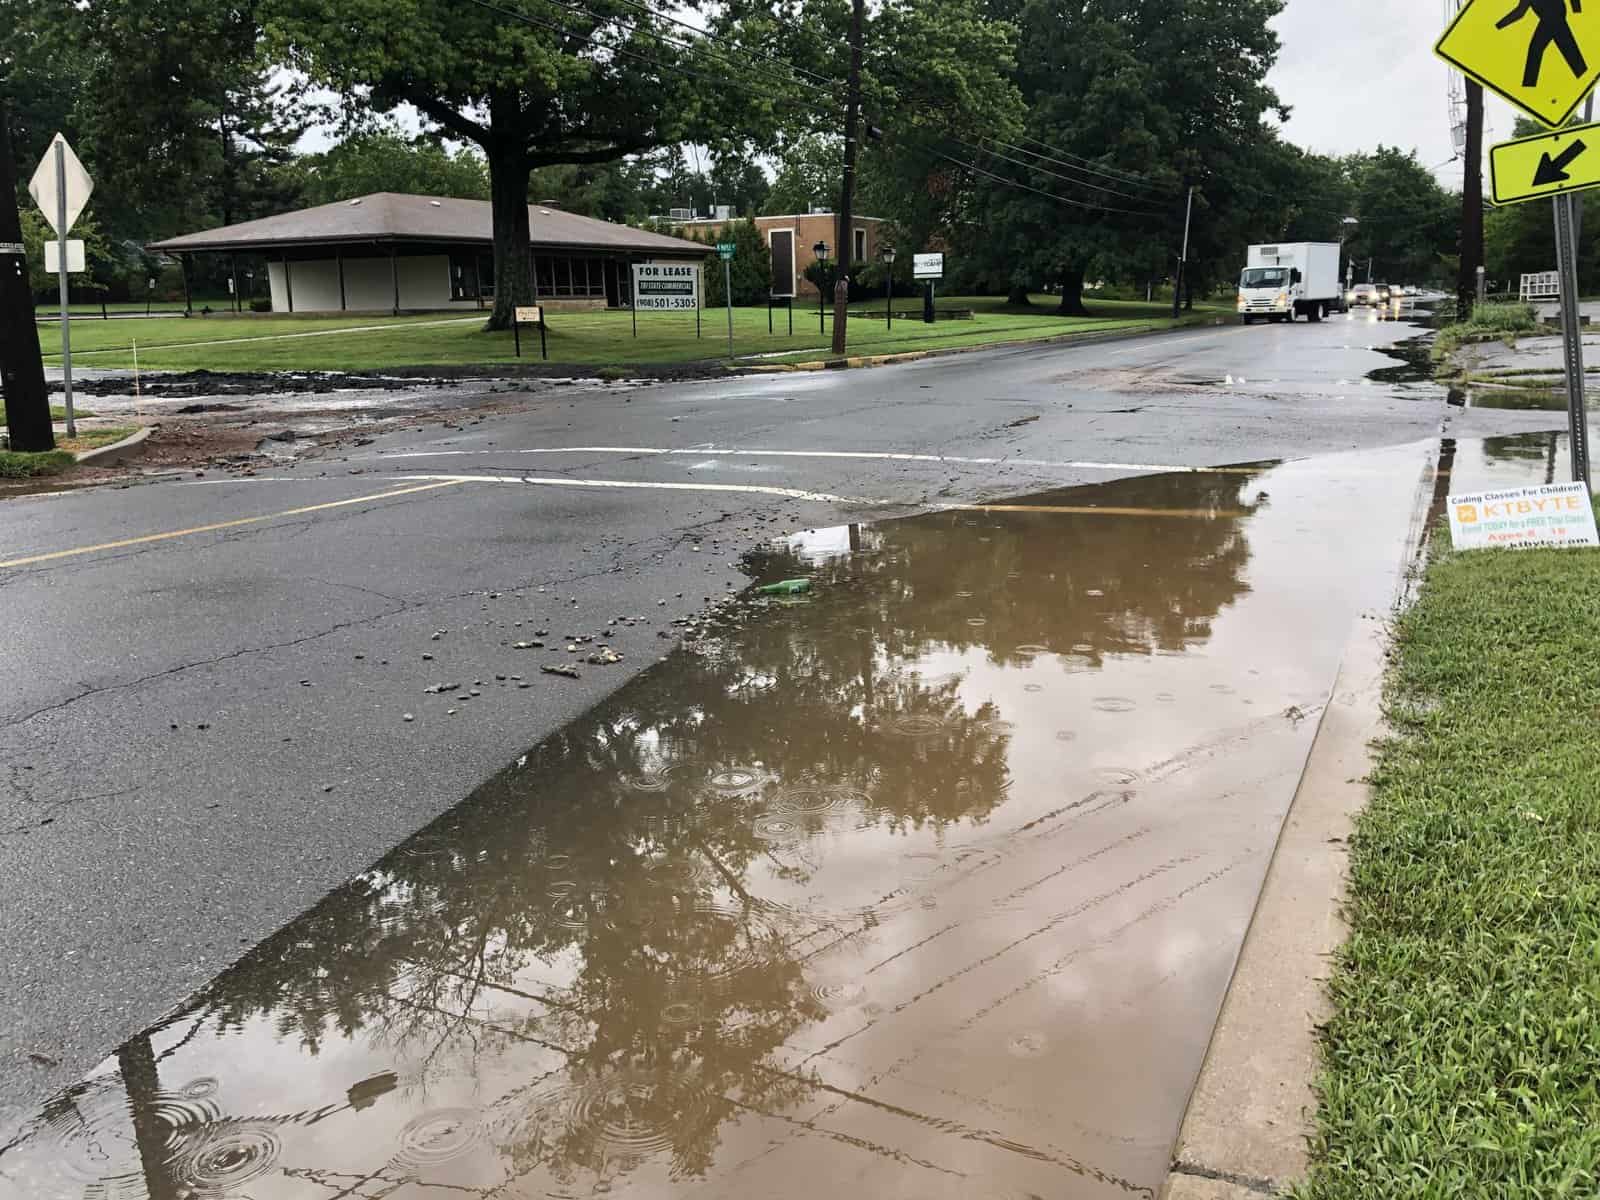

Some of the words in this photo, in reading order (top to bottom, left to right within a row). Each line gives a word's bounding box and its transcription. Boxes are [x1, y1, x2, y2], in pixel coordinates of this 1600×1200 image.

[640, 267, 659, 276] FOR
[663, 267, 692, 276] LEASE
[1451, 495, 1482, 504] Coding
[1485, 491, 1520, 501] Classes
[1523, 488, 1537, 496] For
[1540, 484, 1582, 495] Children!
[1483, 495, 1582, 518] KTBYTE
[1488, 532, 1523, 542] Ages
